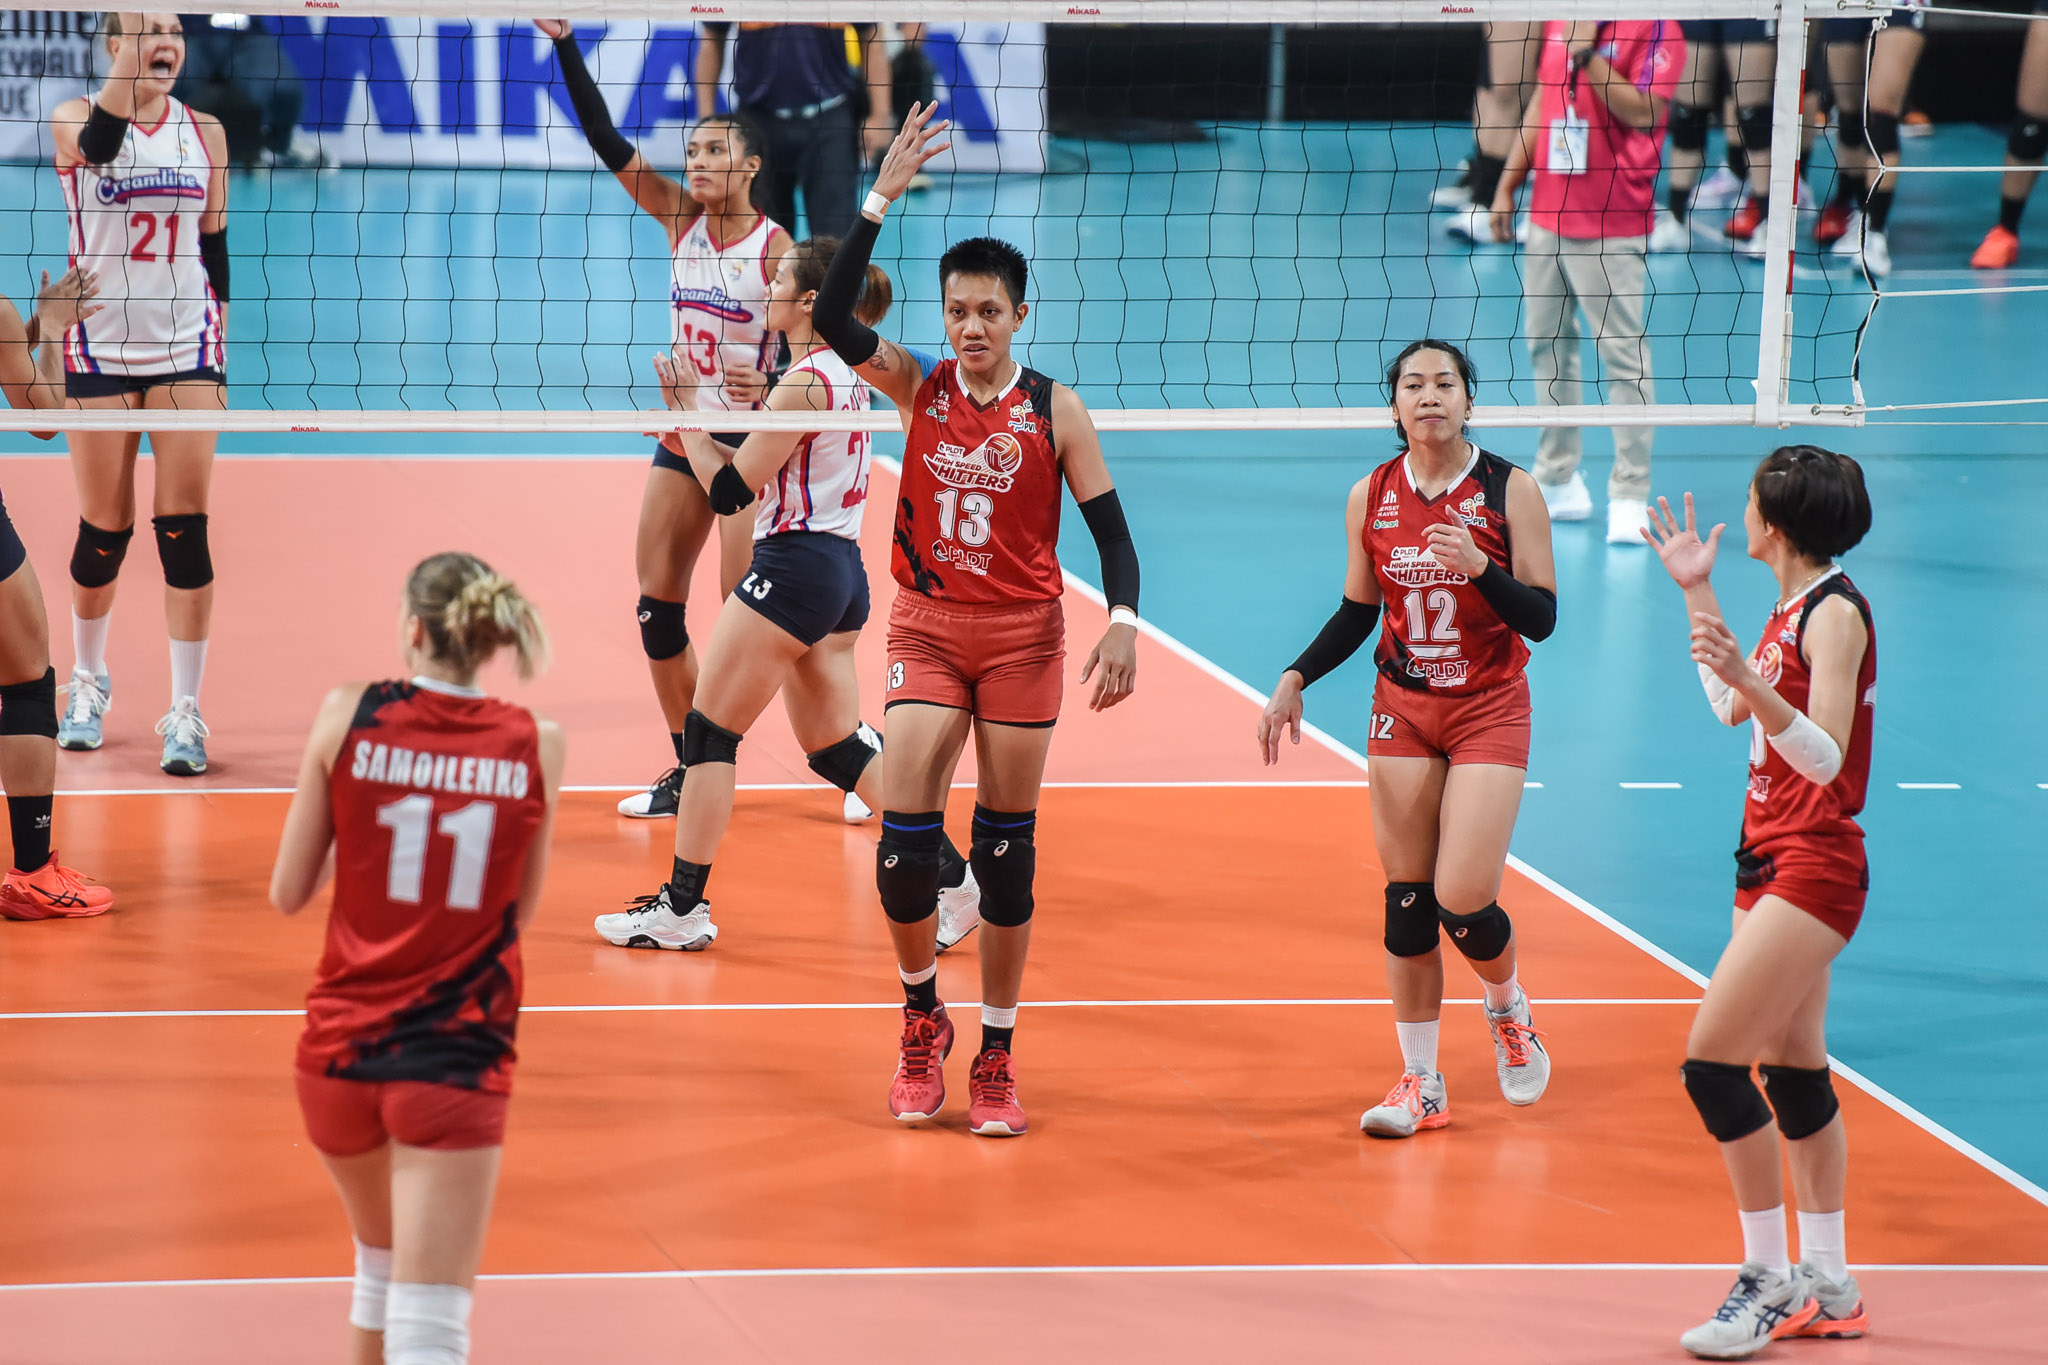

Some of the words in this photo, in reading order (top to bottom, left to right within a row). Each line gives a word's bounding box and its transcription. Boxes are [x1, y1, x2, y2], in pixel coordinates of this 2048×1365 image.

[96, 167, 199, 206] Creamline
[130, 212, 180, 264] 21
[683, 322, 718, 377] 13
[945, 446, 964, 455] PLDT
[934, 455, 954, 466] HIGH
[954, 461, 982, 471] SPEED
[936, 465, 1012, 489] HITTERS
[934, 487, 993, 547] 13
[1473, 516, 1488, 528] PVL
[949, 545, 993, 569] PLDT
[1400, 548, 1417, 556] PLDT
[1391, 561, 1409, 569] HIGH
[1411, 560, 1437, 569] SPEED
[1397, 568, 1467, 582] HITTERS
[1403, 588, 1461, 642] 12
[1423, 660, 1469, 679] PLDT
[1370, 712, 1395, 740] 12
[352, 740, 529, 799] SAMOILENKO
[376, 793, 498, 911] 11
